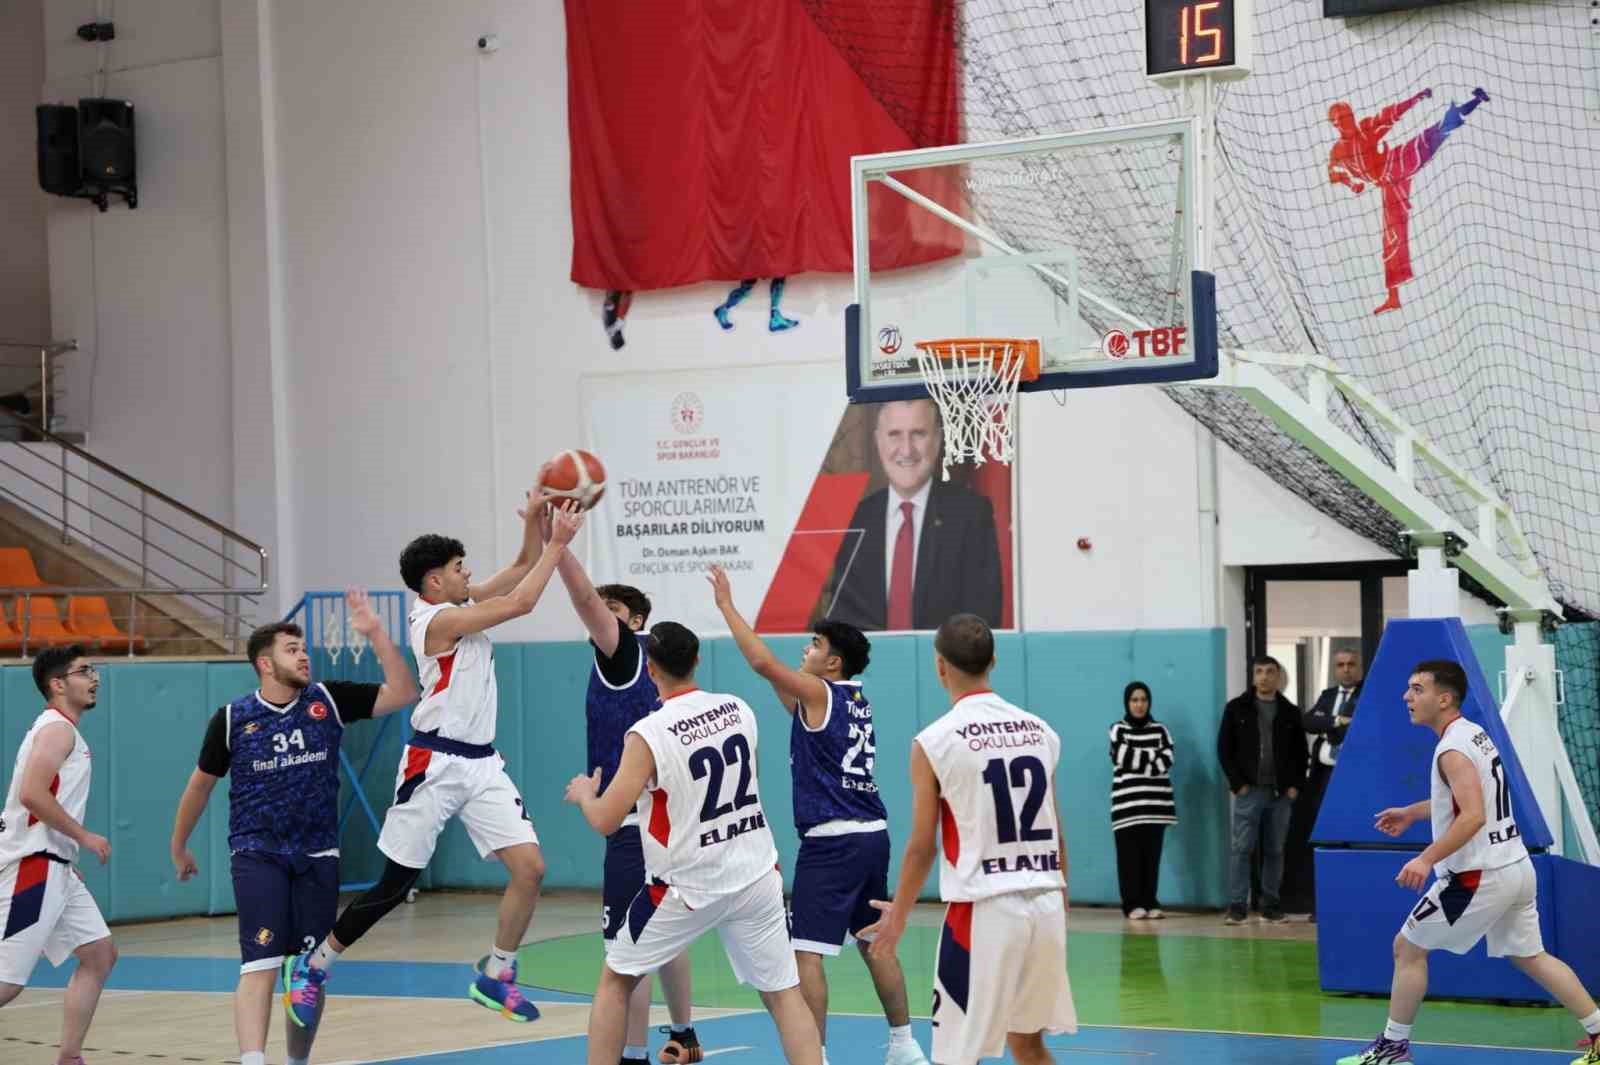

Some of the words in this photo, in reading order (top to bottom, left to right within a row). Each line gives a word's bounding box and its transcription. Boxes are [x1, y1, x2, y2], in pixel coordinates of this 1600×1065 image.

[1181, 1, 1221, 64] 15
[1132, 326, 1187, 357] TBF
[618, 479, 652, 498] TÜM
[656, 474, 738, 497] ANTRENÖR
[741, 475, 760, 493] VE
[624, 496, 757, 518] SPORCULARIMIZA
[616, 522, 688, 540] BAŞARILAR
[691, 518, 765, 534] DİLİYORUM
[642, 547, 656, 558] Dr.
[657, 547, 690, 557] Osman
[720, 544, 740, 555] BAK
[672, 561, 685, 573] VE
[687, 560, 716, 573] SPO
[272, 728, 305, 753] 34
[252, 756, 278, 772] final
[280, 748, 329, 767] akademi
[688, 733, 758, 824] 22
[983, 754, 1053, 844] 12
[1412, 896, 1439, 921] 17
